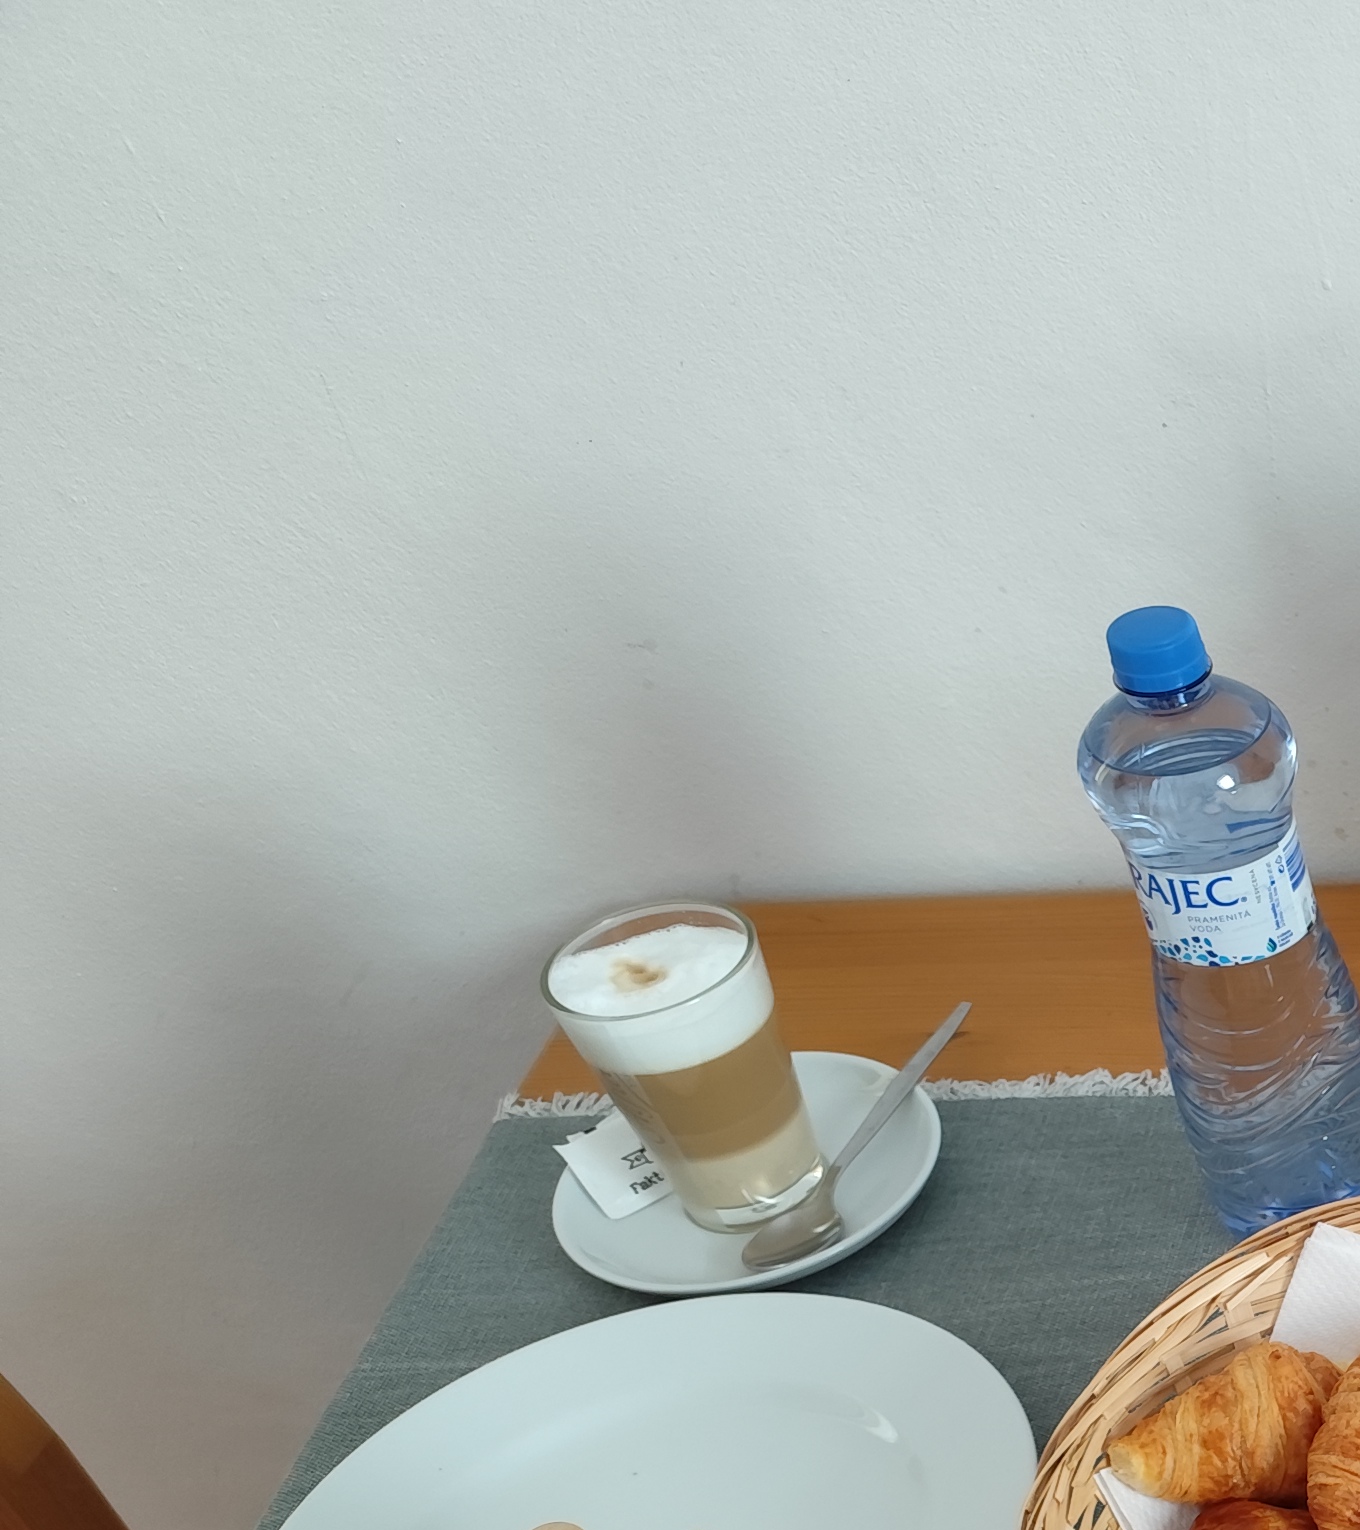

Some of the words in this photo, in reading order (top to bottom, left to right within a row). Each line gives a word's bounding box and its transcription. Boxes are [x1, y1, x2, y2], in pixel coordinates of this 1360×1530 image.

[1128, 860, 1239, 915] RAJEC
[1190, 924, 1222, 933] VODA
[629, 1171, 665, 1195] Fakt
